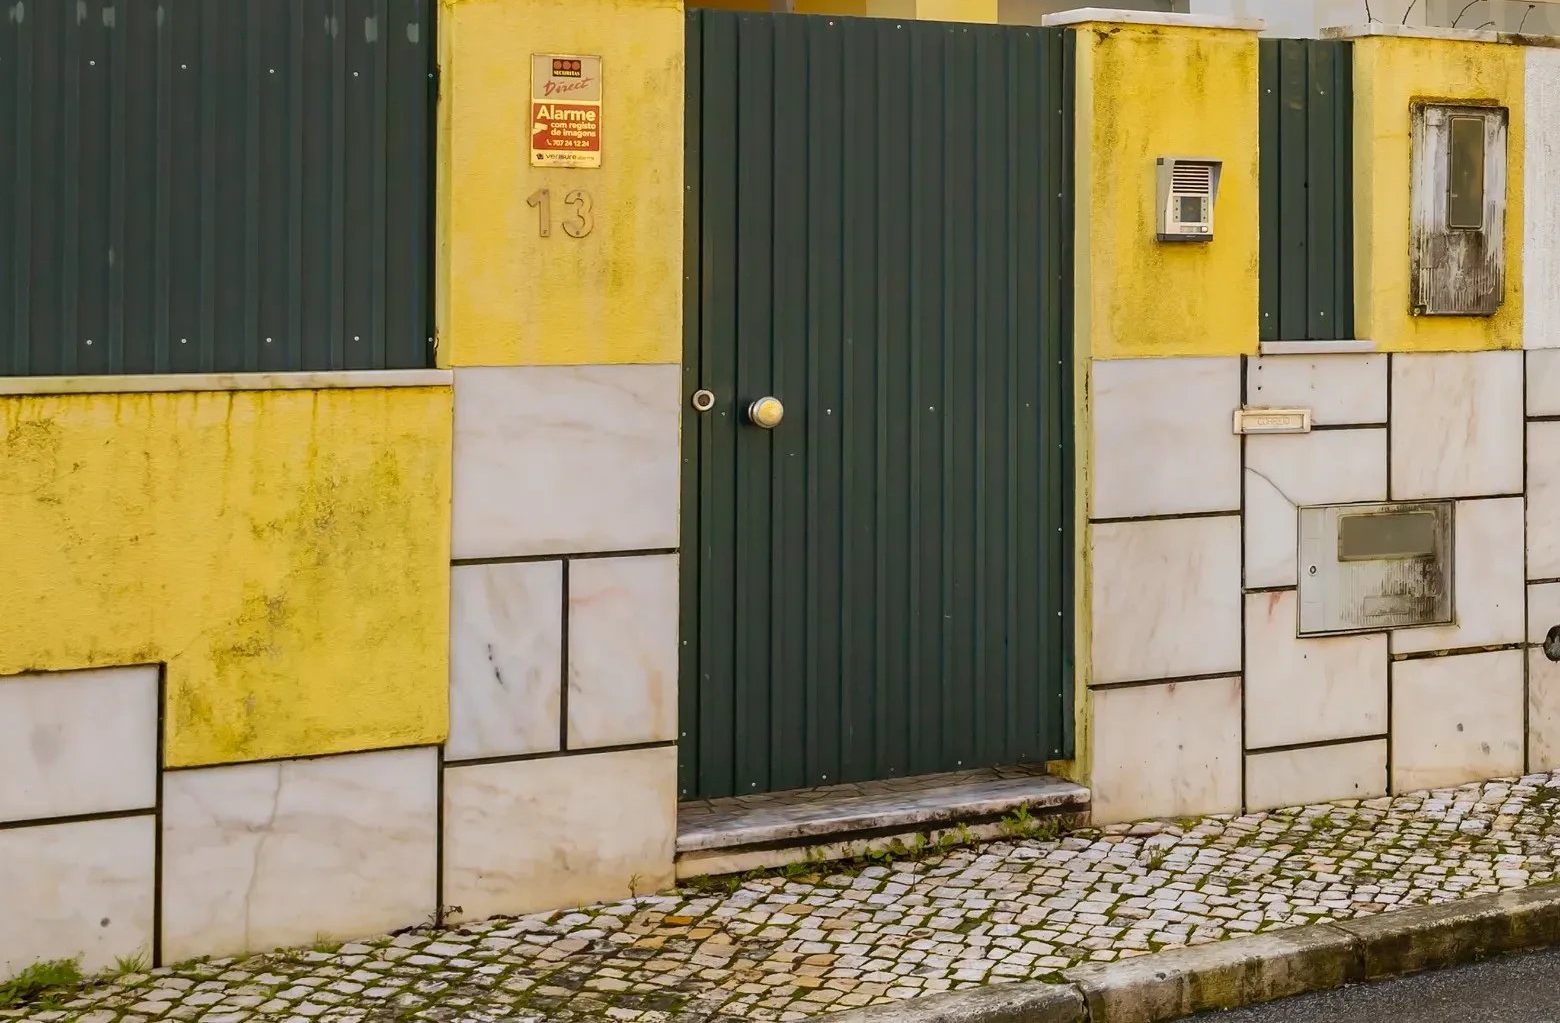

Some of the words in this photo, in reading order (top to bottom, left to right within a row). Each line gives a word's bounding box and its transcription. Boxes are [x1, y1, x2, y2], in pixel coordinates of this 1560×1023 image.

[544, 77, 594, 96] Direct
[537, 104, 596, 121] Alarme
[551, 128, 561, 136] de
[563, 128, 596, 138] imagens
[569, 122, 596, 130] registo
[526, 189, 594, 238] 13
